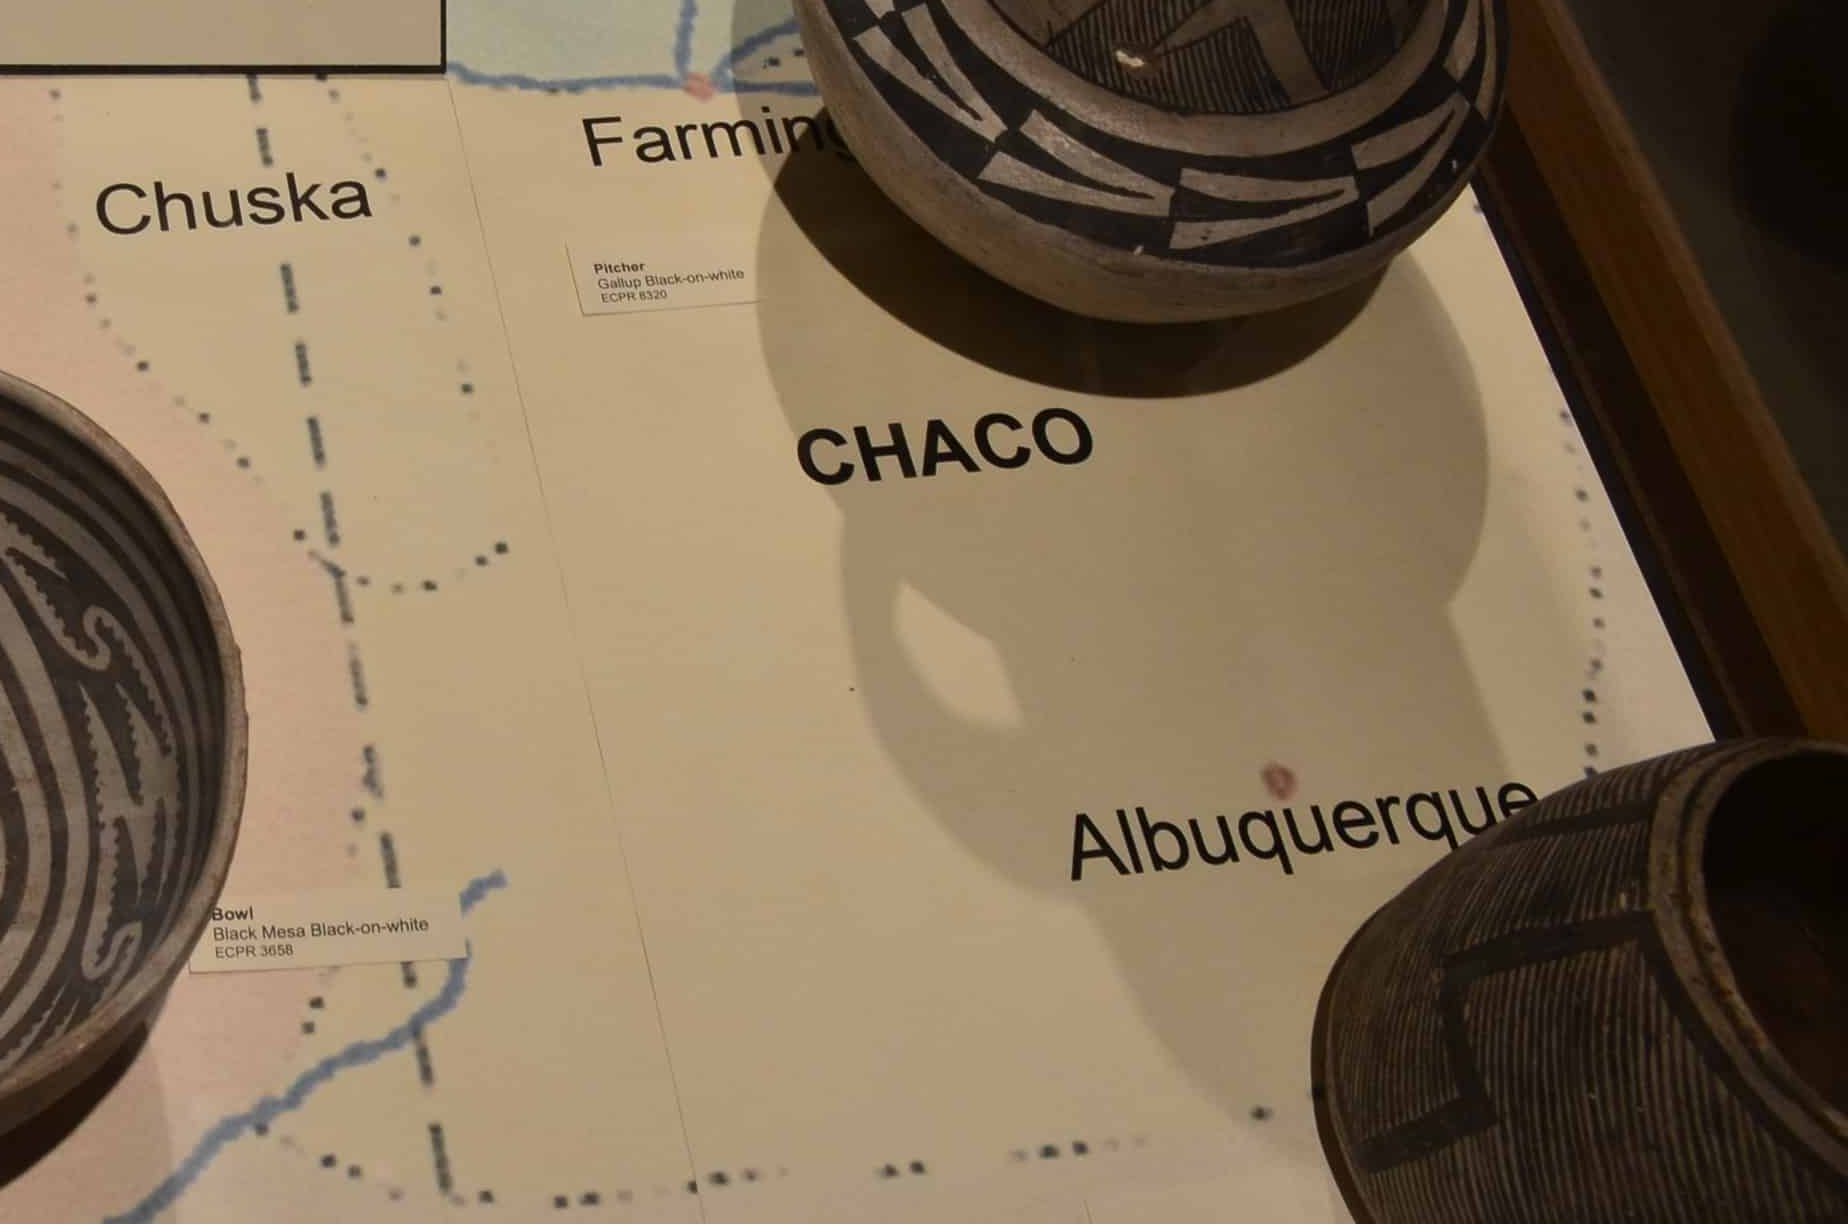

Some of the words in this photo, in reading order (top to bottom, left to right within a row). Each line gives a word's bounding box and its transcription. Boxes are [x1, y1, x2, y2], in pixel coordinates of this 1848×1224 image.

[95, 170, 373, 235] Chuska
[593, 262, 646, 275] Pitcher
[597, 277, 642, 291] Gallup
[644, 269, 745, 287] Black-on-white
[600, 292, 637, 304] ECPR
[796, 407, 1093, 486] CHACO
[1070, 780, 1538, 881] Albuquerque
[212, 905, 253, 921] Bowl
[213, 926, 258, 941] Black
[261, 925, 306, 939] Mesa
[310, 917, 430, 937] Black-on-white
[215, 945, 257, 958] ECPR
[260, 943, 294, 957] 3658
